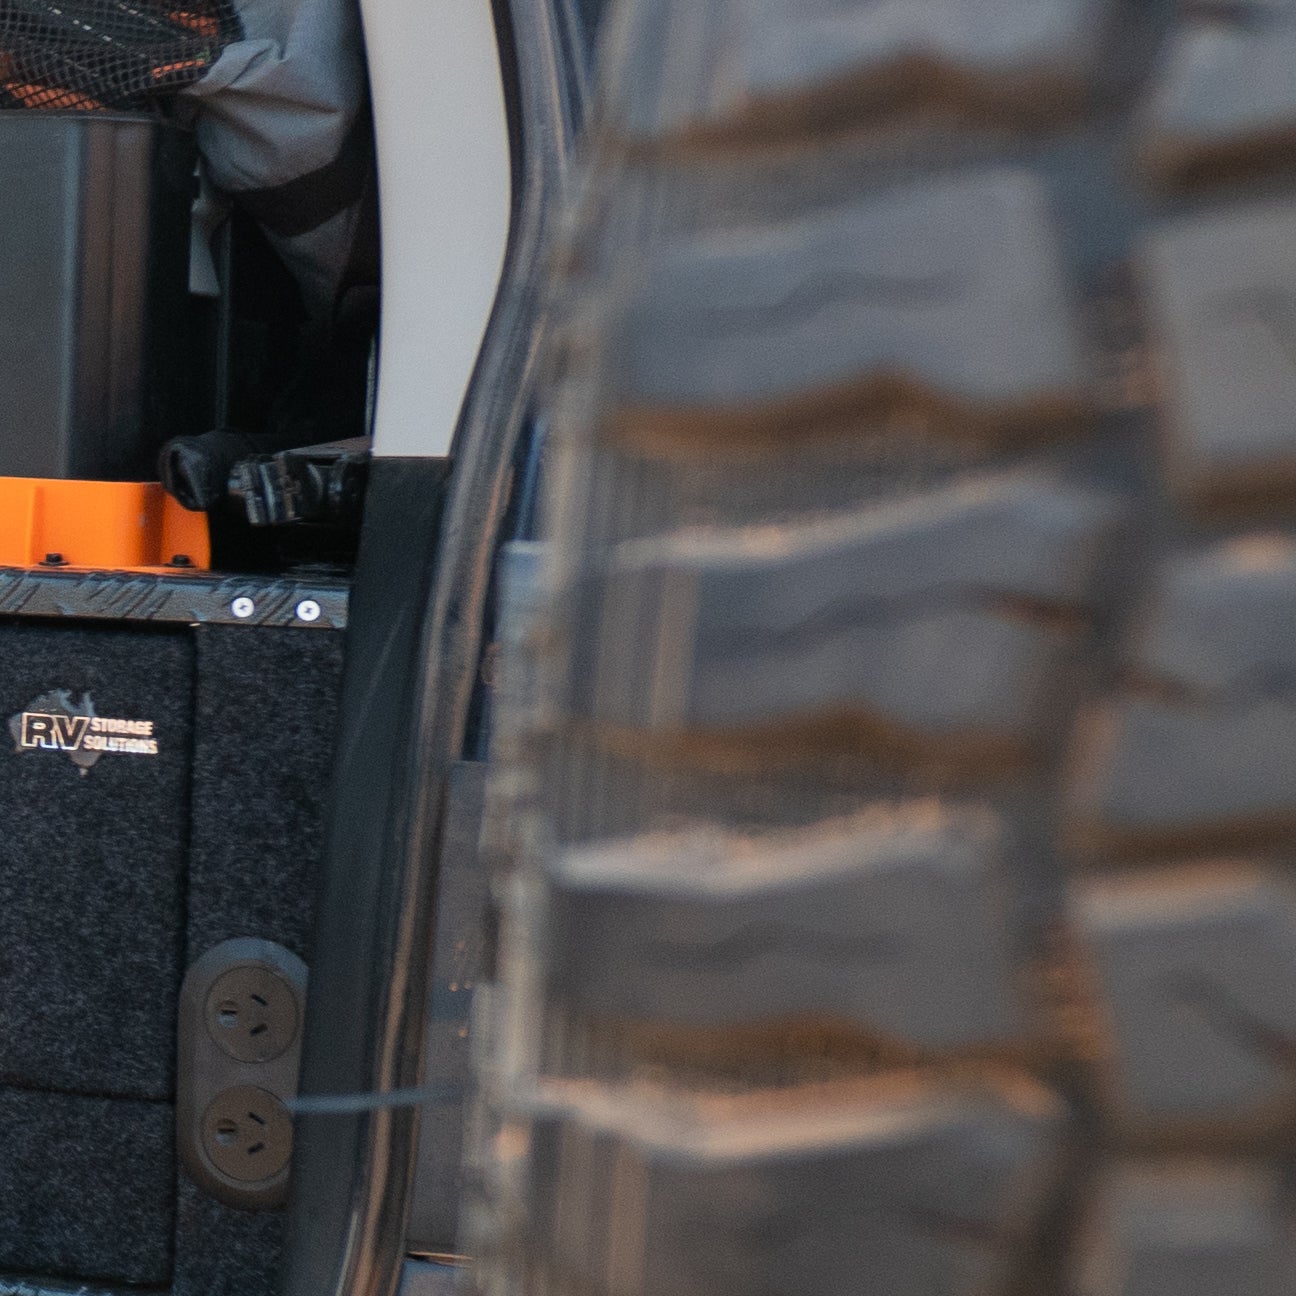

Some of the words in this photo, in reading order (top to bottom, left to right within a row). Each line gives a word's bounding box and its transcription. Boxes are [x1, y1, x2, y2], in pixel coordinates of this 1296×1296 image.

[20, 711, 92, 751] RV
[90, 717, 154, 736] STORAGE
[83, 735, 159, 755] SOLUTIONS
